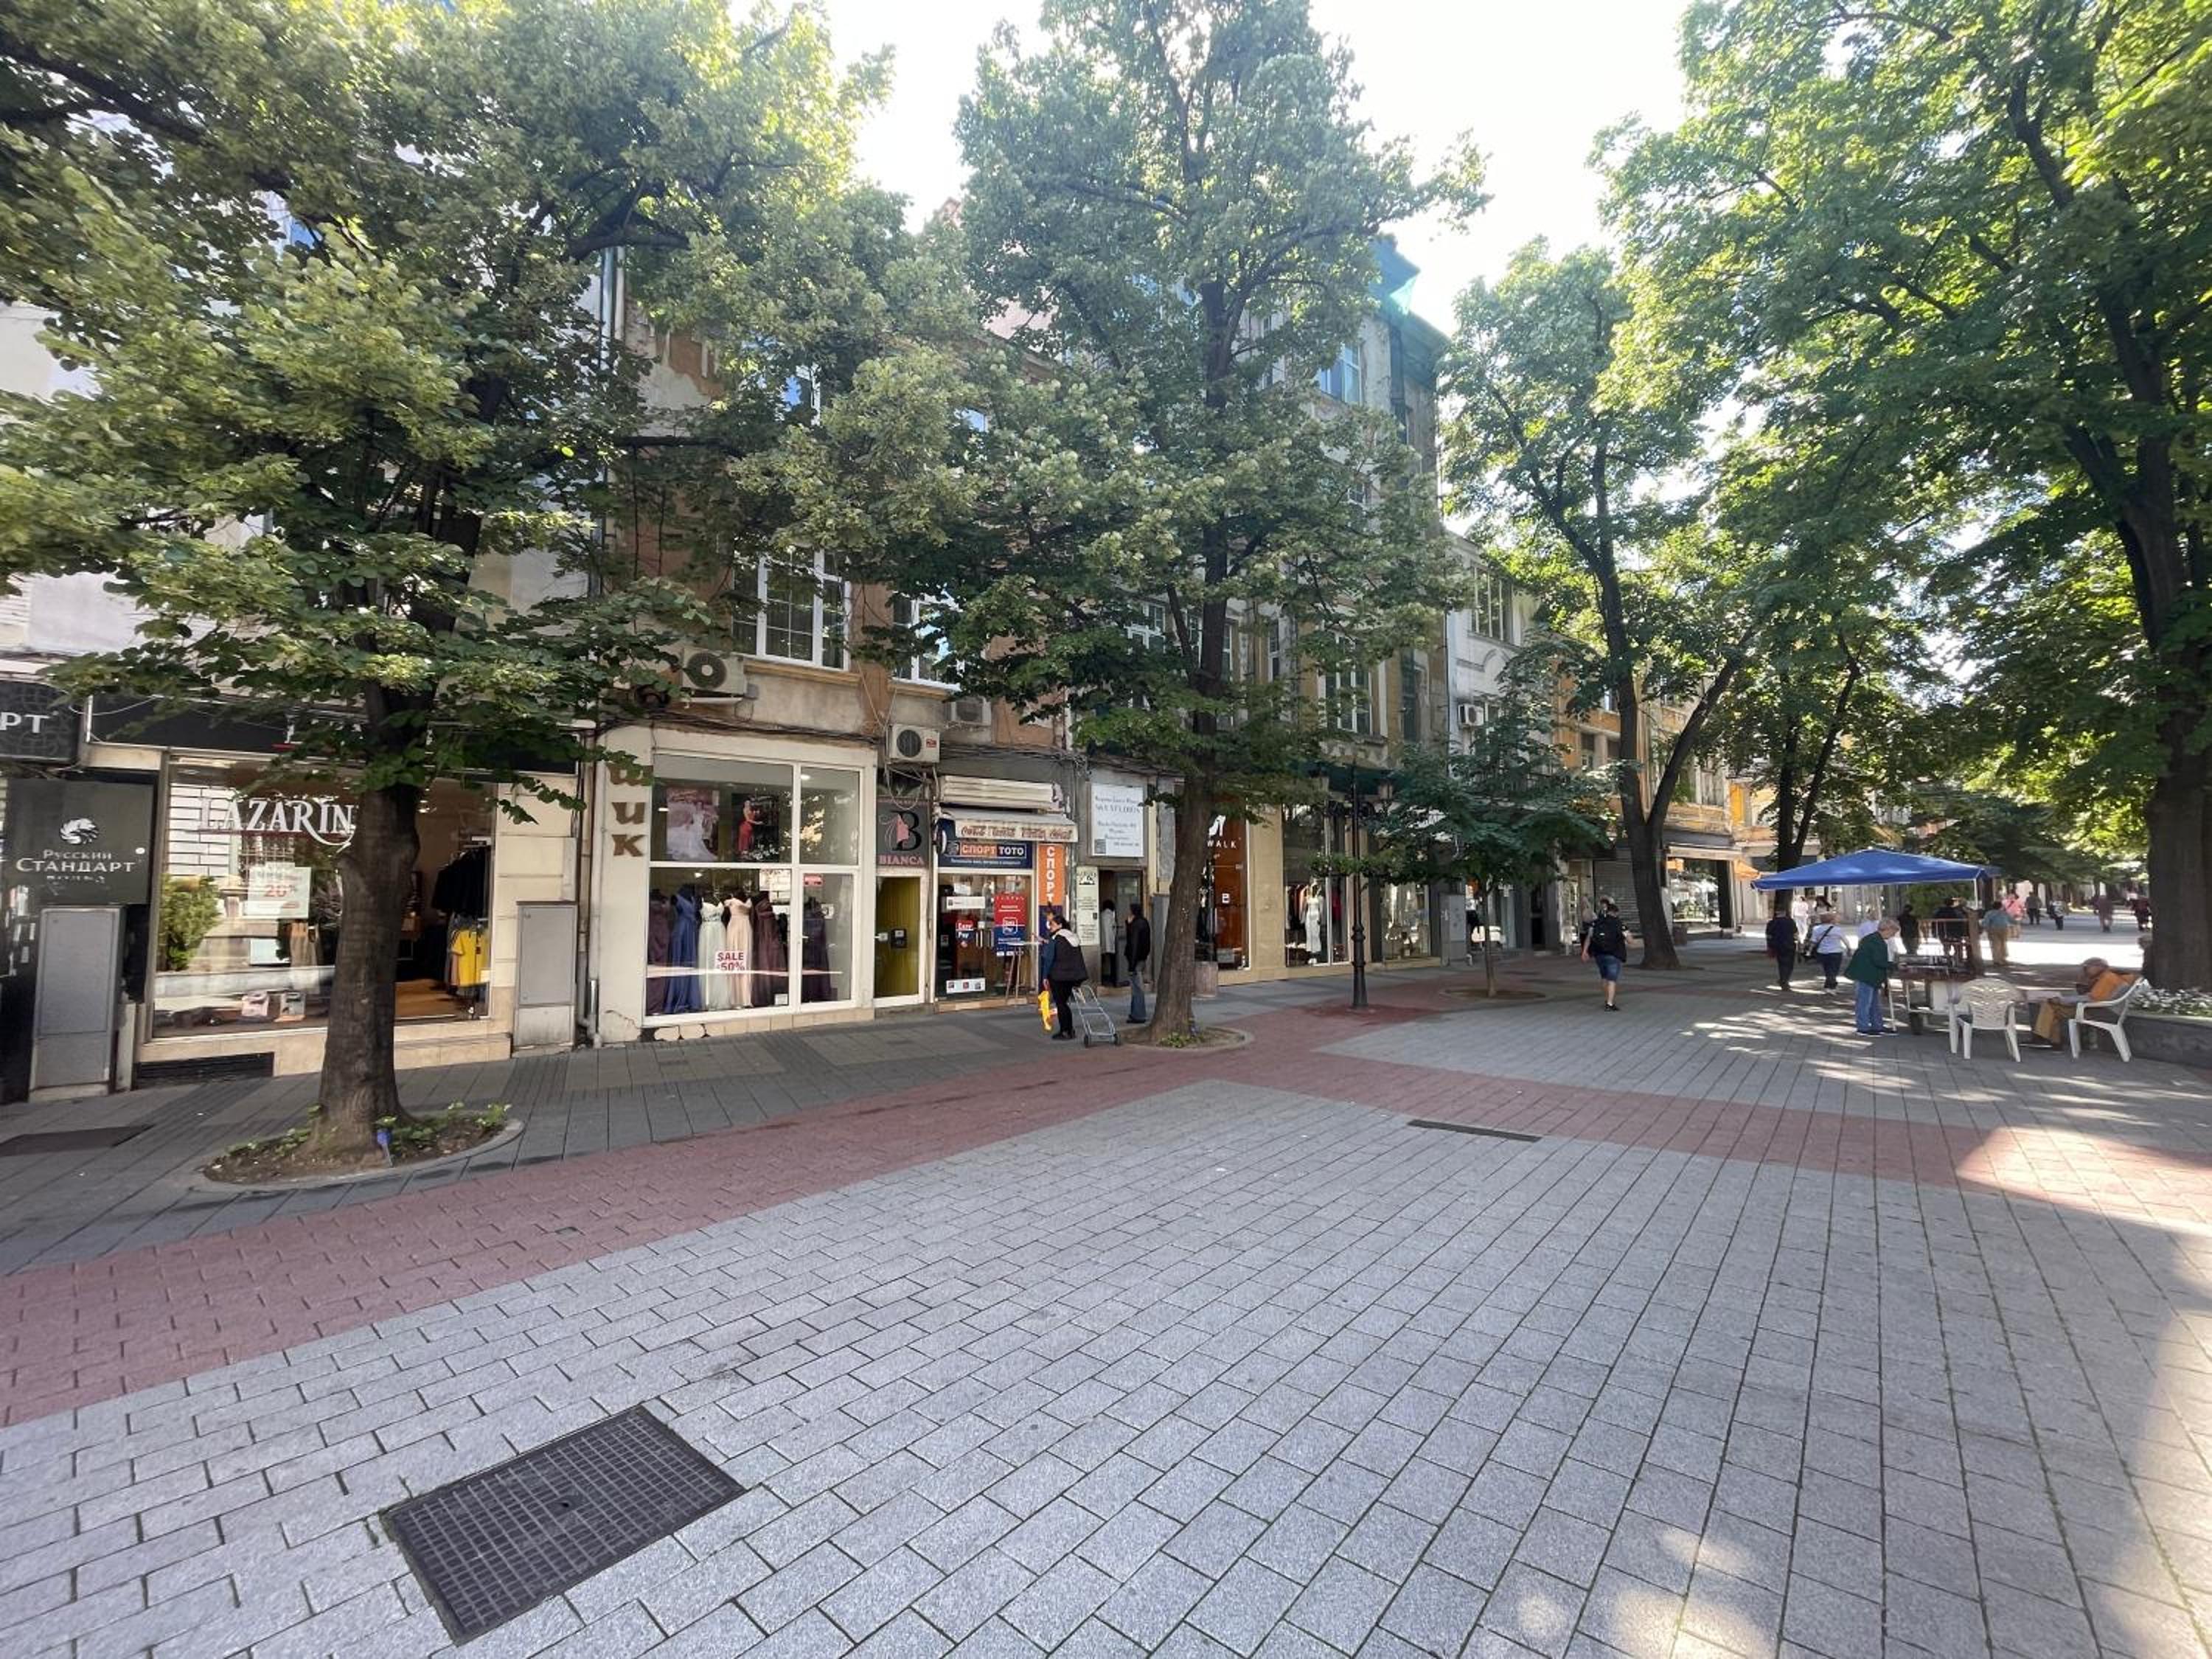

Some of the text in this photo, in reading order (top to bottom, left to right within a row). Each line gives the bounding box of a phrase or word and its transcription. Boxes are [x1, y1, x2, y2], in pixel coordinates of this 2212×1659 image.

[961, 845, 1024, 856] СПОРТ ТОТО
[879, 855, 925, 866] BIANCA
[1046, 846, 1055, 902] СПОРТ
[717, 952, 744, 961] SALE
